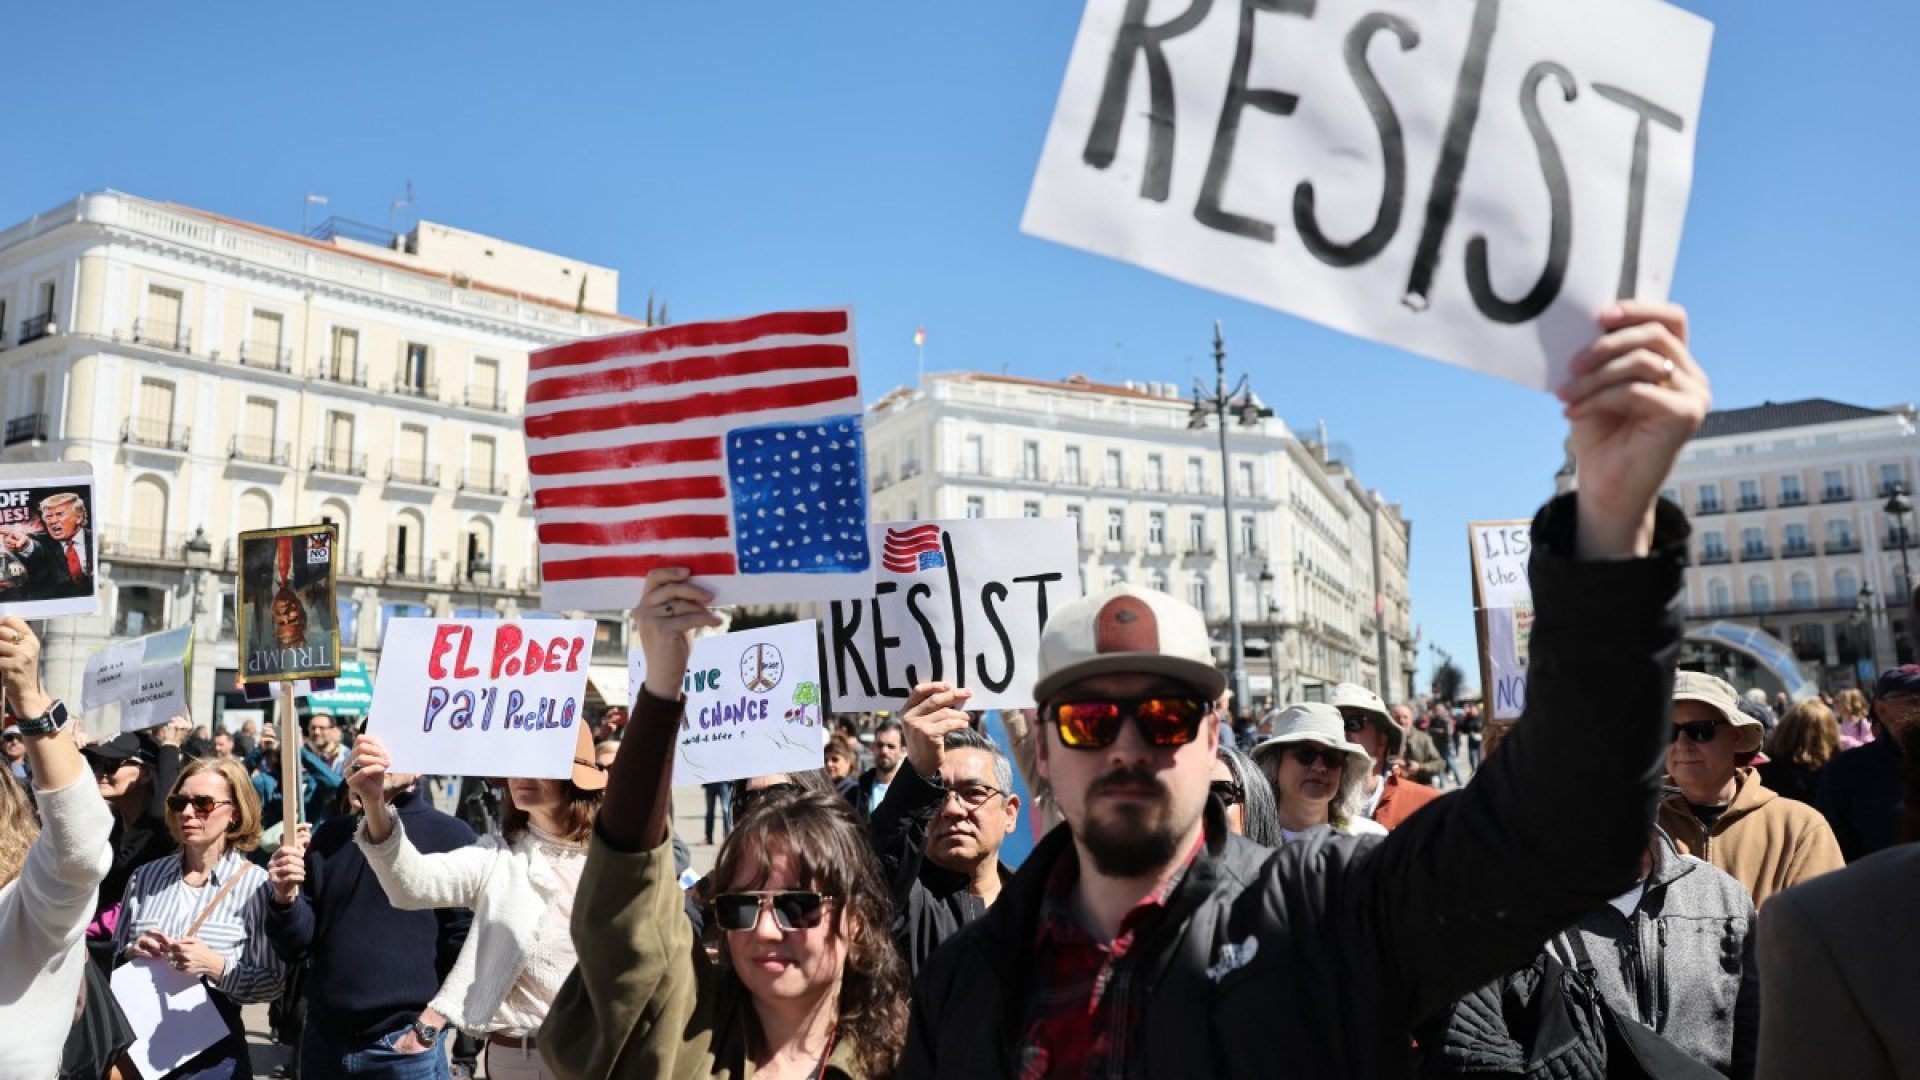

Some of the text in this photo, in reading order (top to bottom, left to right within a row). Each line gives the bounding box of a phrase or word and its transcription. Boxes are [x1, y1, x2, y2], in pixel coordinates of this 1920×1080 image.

[1083, 0, 1684, 324] RESIST
[1482, 530, 1531, 559] LIS
[1487, 567, 1518, 586] the
[830, 530, 1062, 698] RESIST
[250, 646, 331, 671] TRUMP
[429, 624, 480, 680] EL
[684, 668, 721, 693] ive
